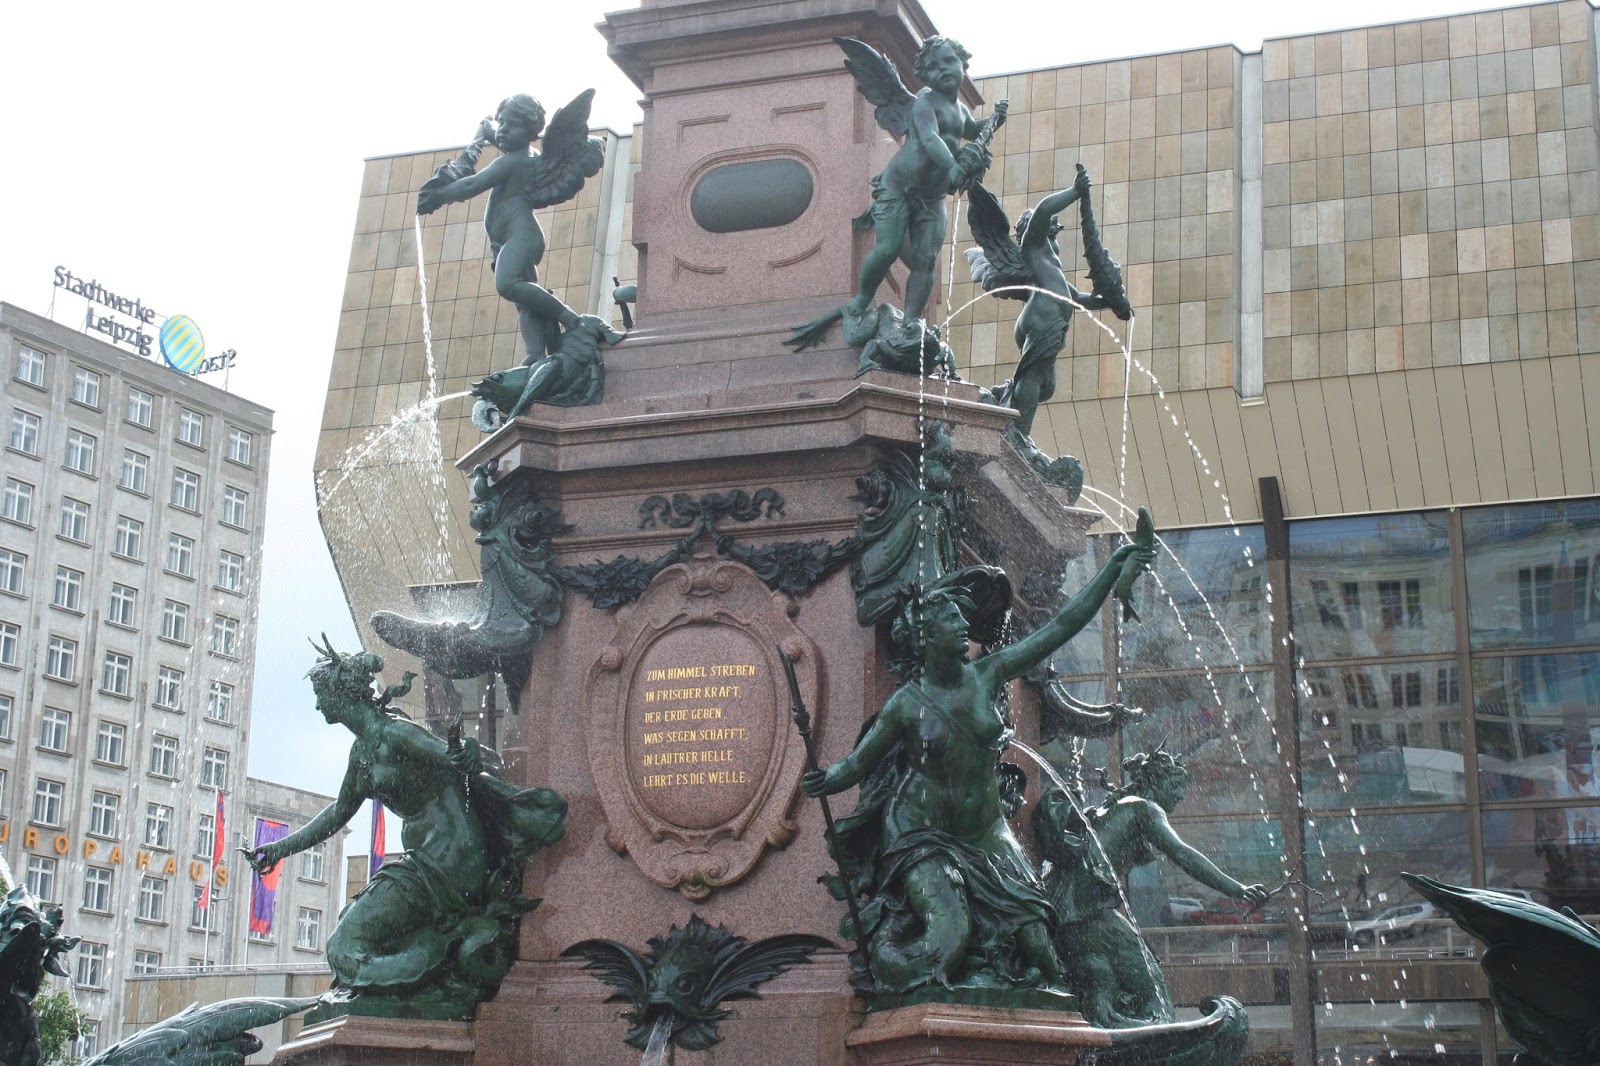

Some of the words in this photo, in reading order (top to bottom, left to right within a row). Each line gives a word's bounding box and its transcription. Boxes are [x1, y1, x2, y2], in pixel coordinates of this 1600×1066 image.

[53, 265, 155, 325] Stadtwerke
[87, 307, 154, 357] Leipzig
[647, 669, 666, 681] ZUM
[667, 666, 707, 680] HIMMEL
[710, 665, 755, 677] STREBEN
[645, 691, 655, 702] IN
[657, 688, 702, 701] FRISCHER
[645, 711, 661, 723] DER
[664, 709, 689, 722] ERDE
[644, 732, 664, 744] WAS
[667, 730, 697, 742] SEGEN
[654, 751, 699, 765] LAUTRER
[701, 750, 734, 762] HELLE
[643, 774, 673, 787] LEHRT
[676, 773, 689, 785] ES
[690, 772, 705, 784] DIE
